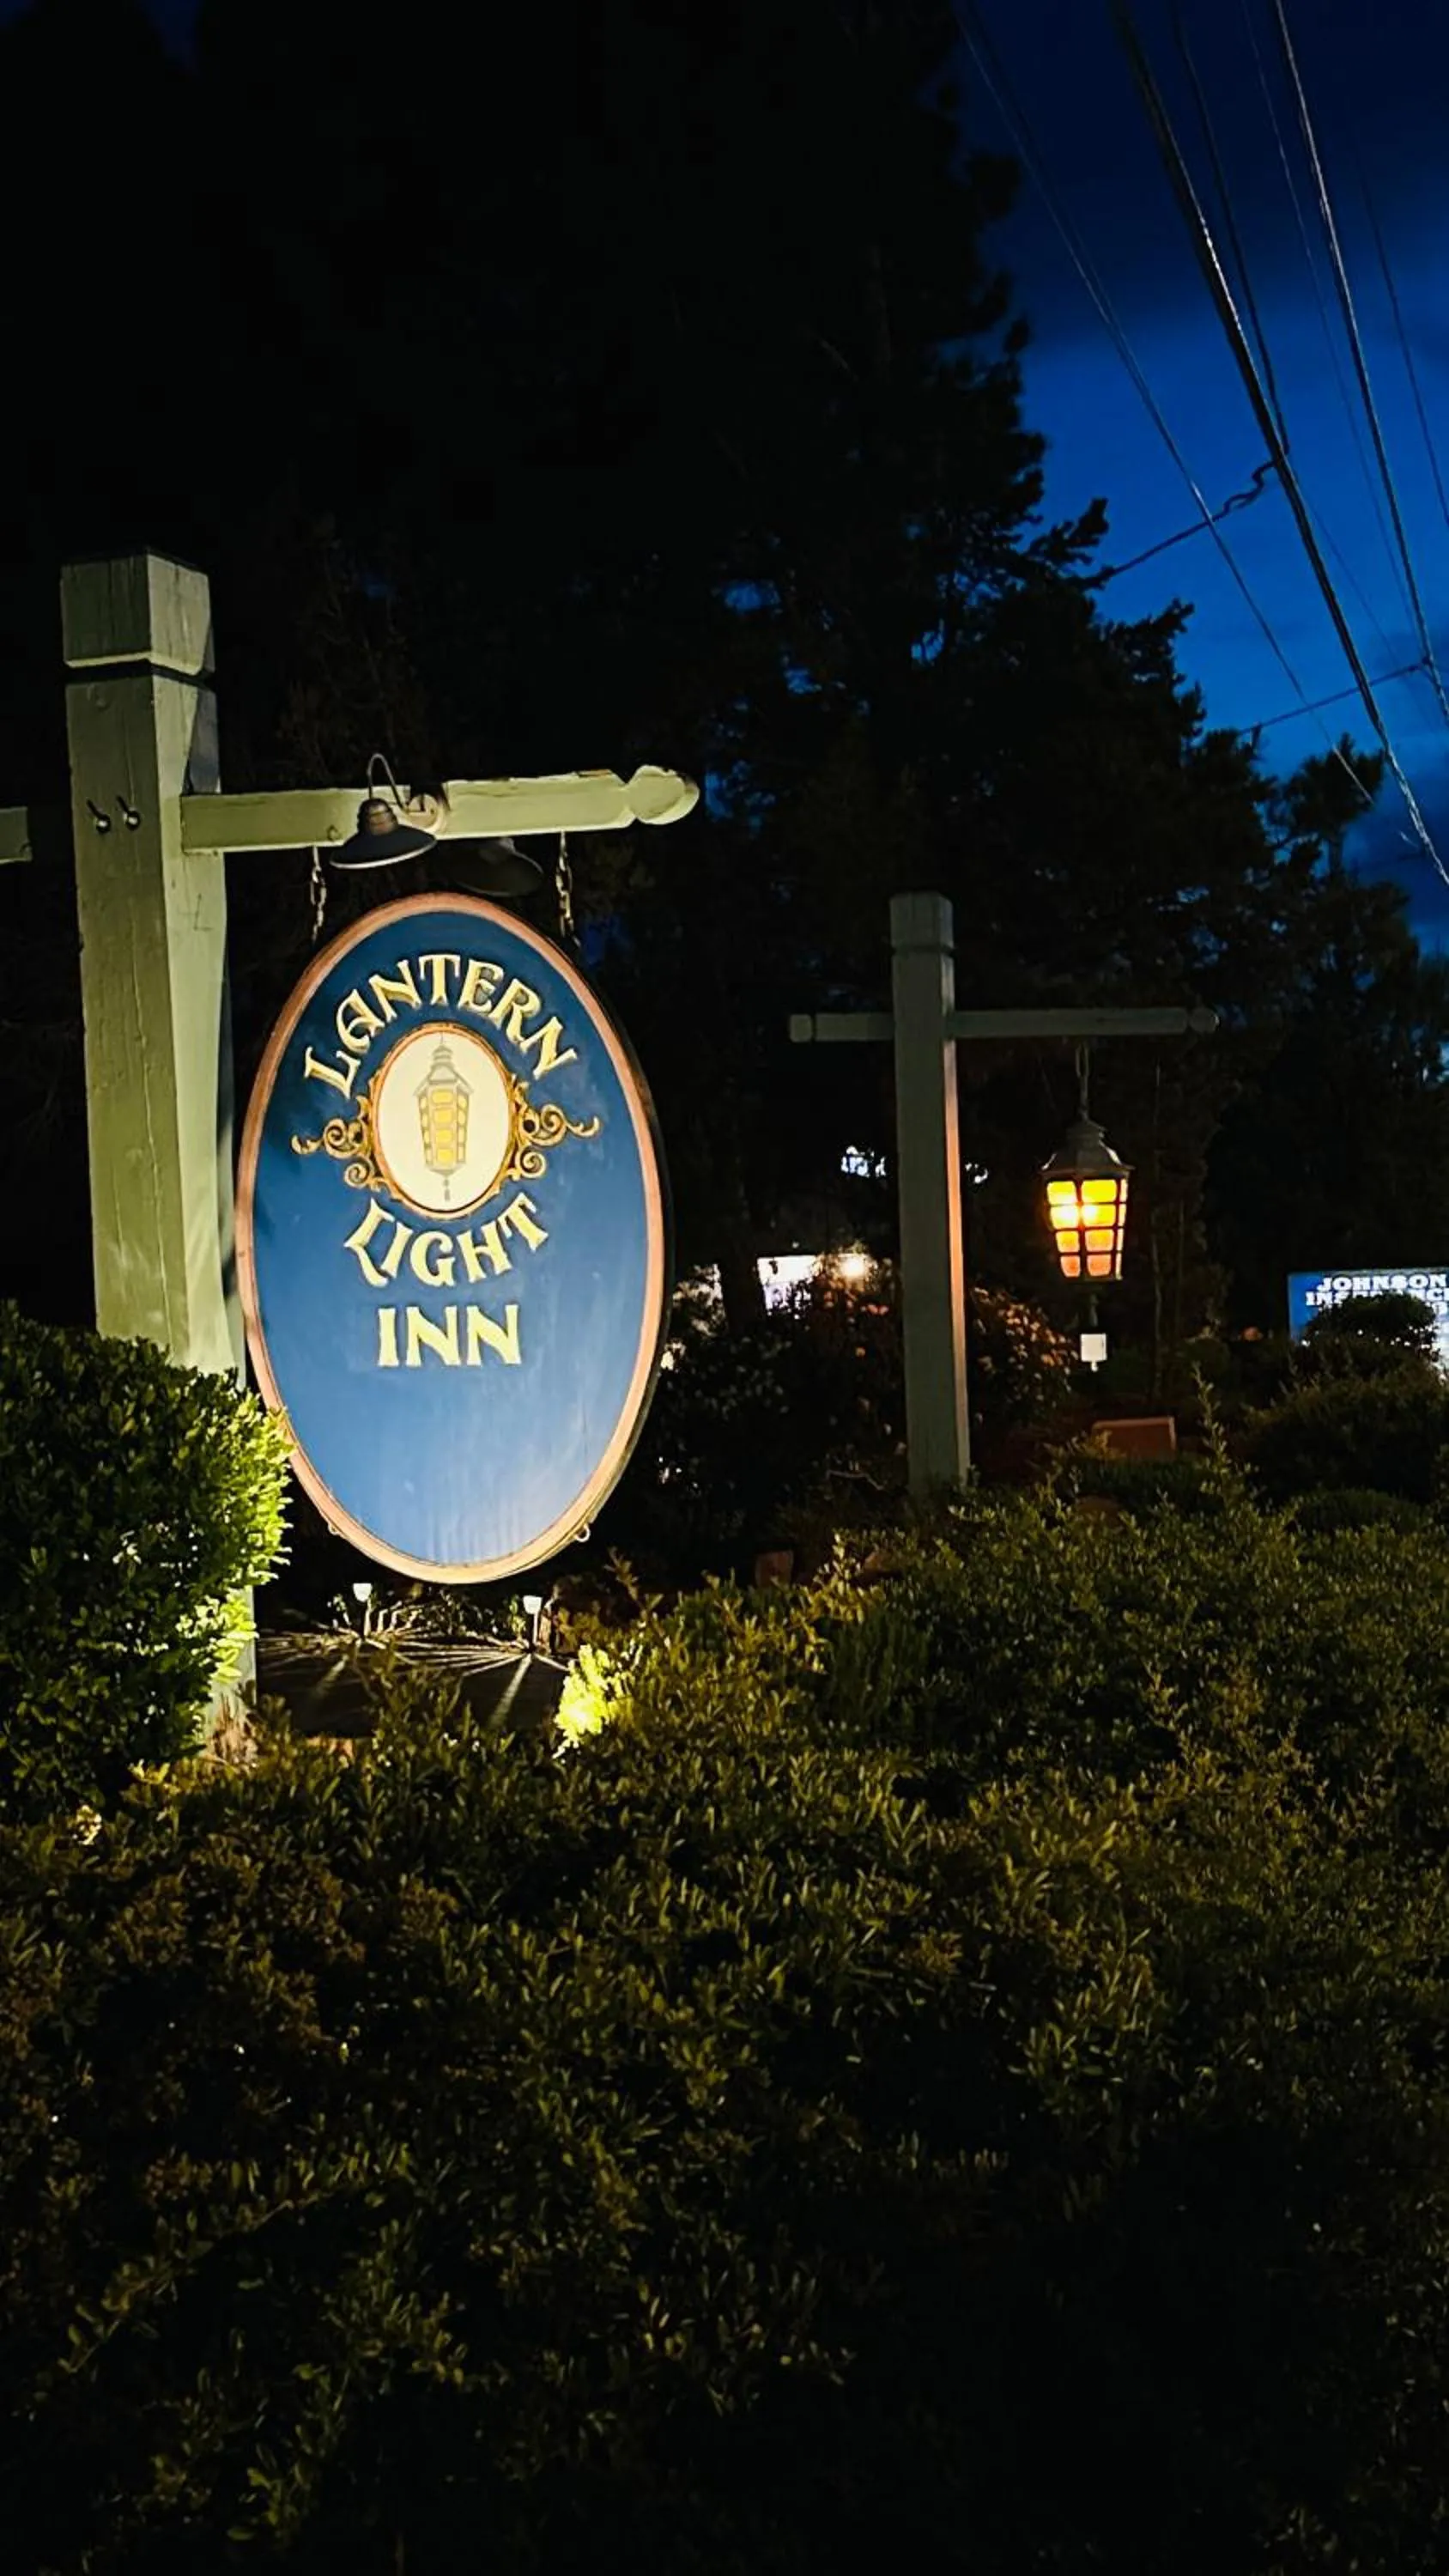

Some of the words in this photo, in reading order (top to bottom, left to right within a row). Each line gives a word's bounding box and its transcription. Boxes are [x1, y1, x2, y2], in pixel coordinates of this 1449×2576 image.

[304, 953, 578, 1098] LANTERN
[344, 1193, 549, 1287] LIGHT
[1317, 1273, 1446, 1291] JOHNSON
[378, 1304, 522, 1367] INN
